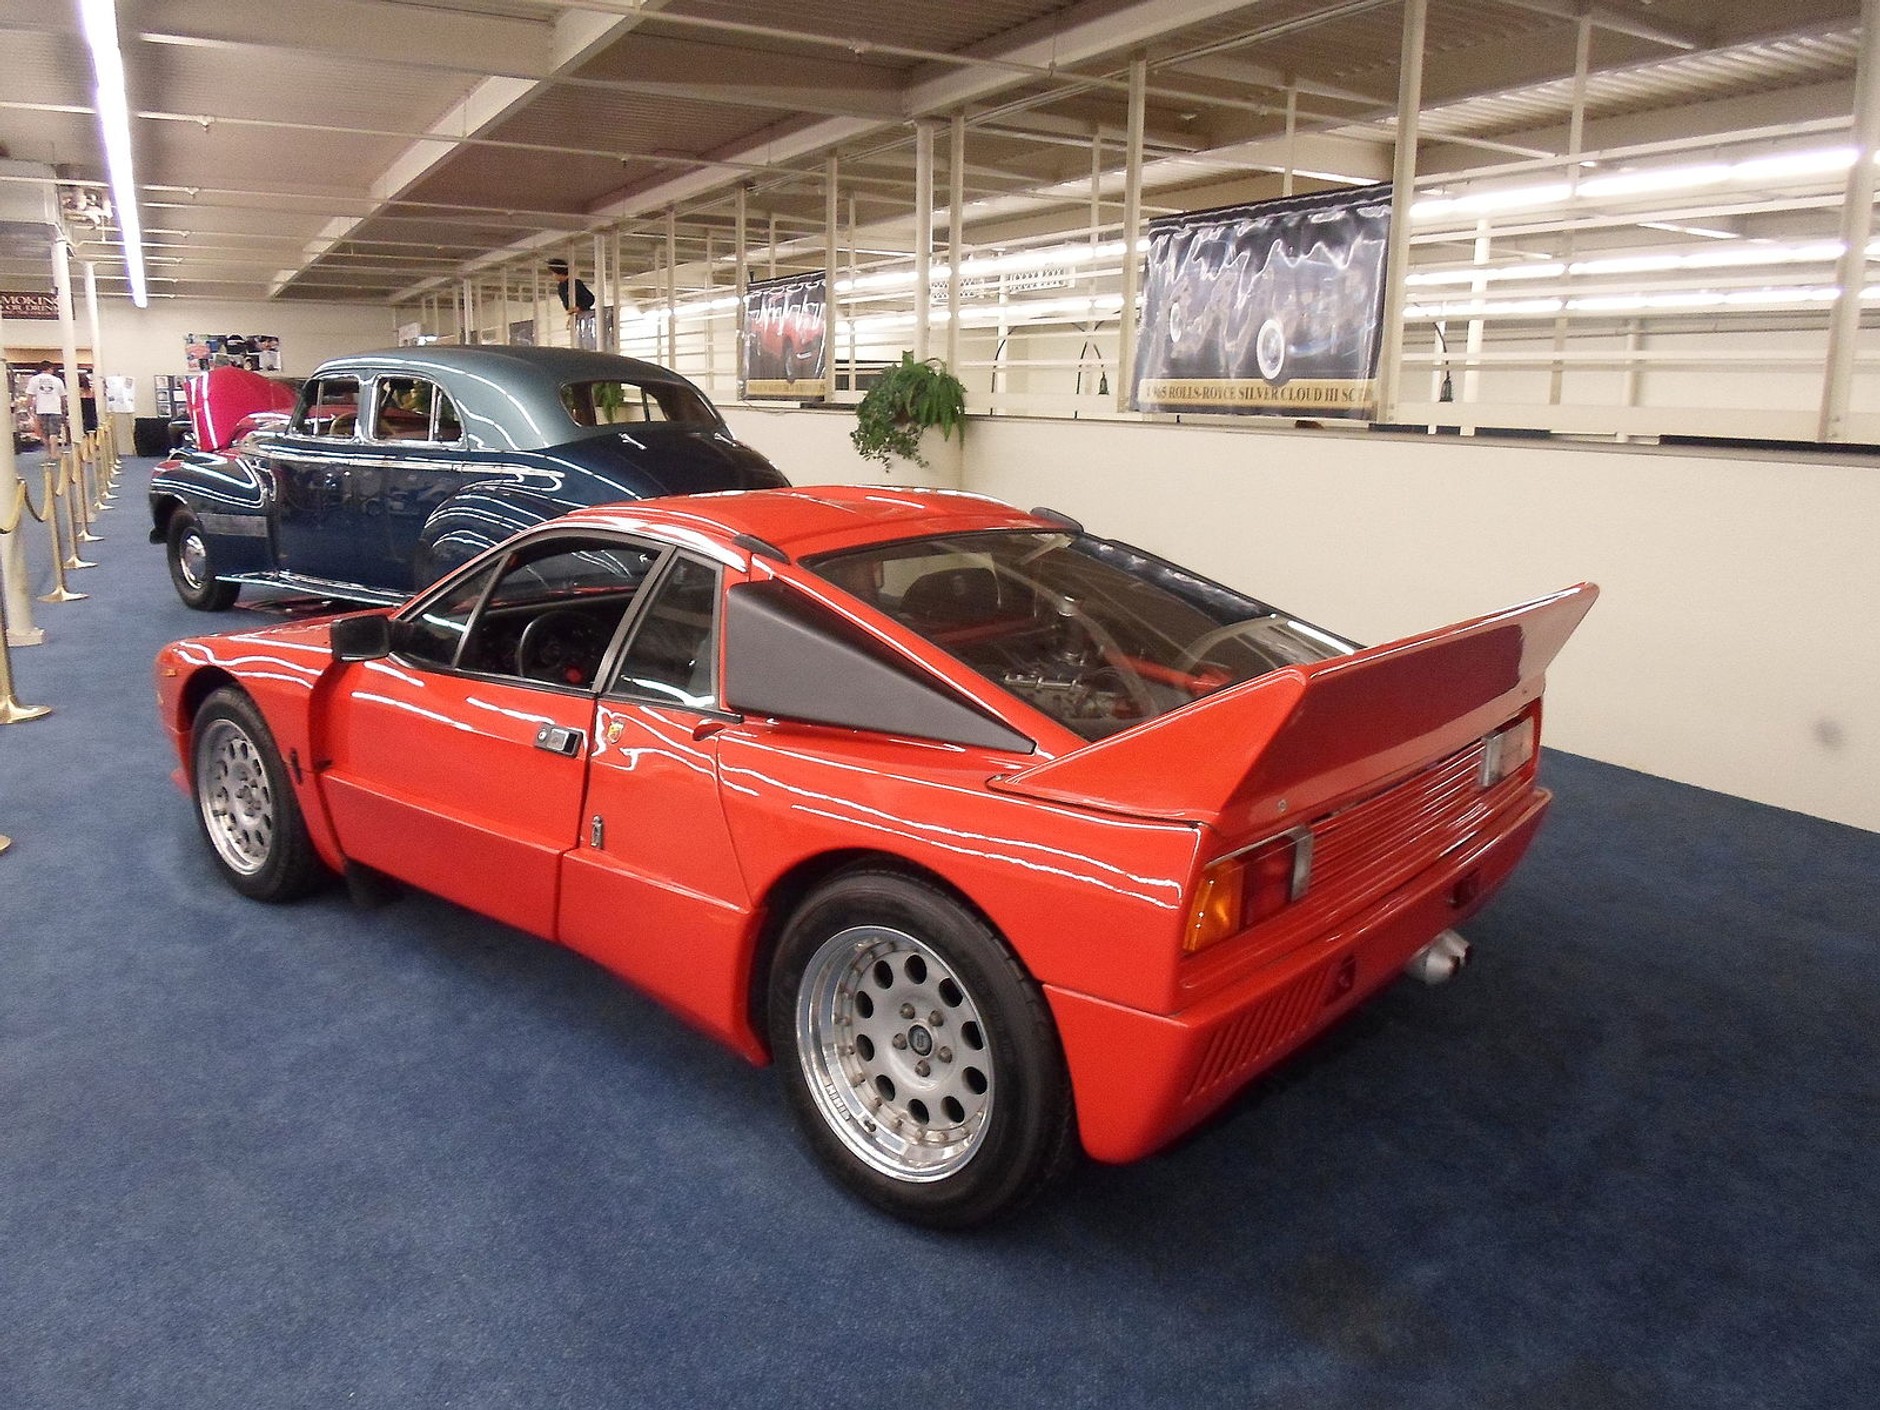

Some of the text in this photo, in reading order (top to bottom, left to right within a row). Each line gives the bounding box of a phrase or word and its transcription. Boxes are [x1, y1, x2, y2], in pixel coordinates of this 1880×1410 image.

[1, 295, 58, 305] MOKIN
[1168, 386, 1235, 400] ROLLS-ROYCE
[1236, 386, 1279, 401] SILVER
[1280, 386, 1321, 402] CLOUD
[1325, 387, 1339, 402] III
